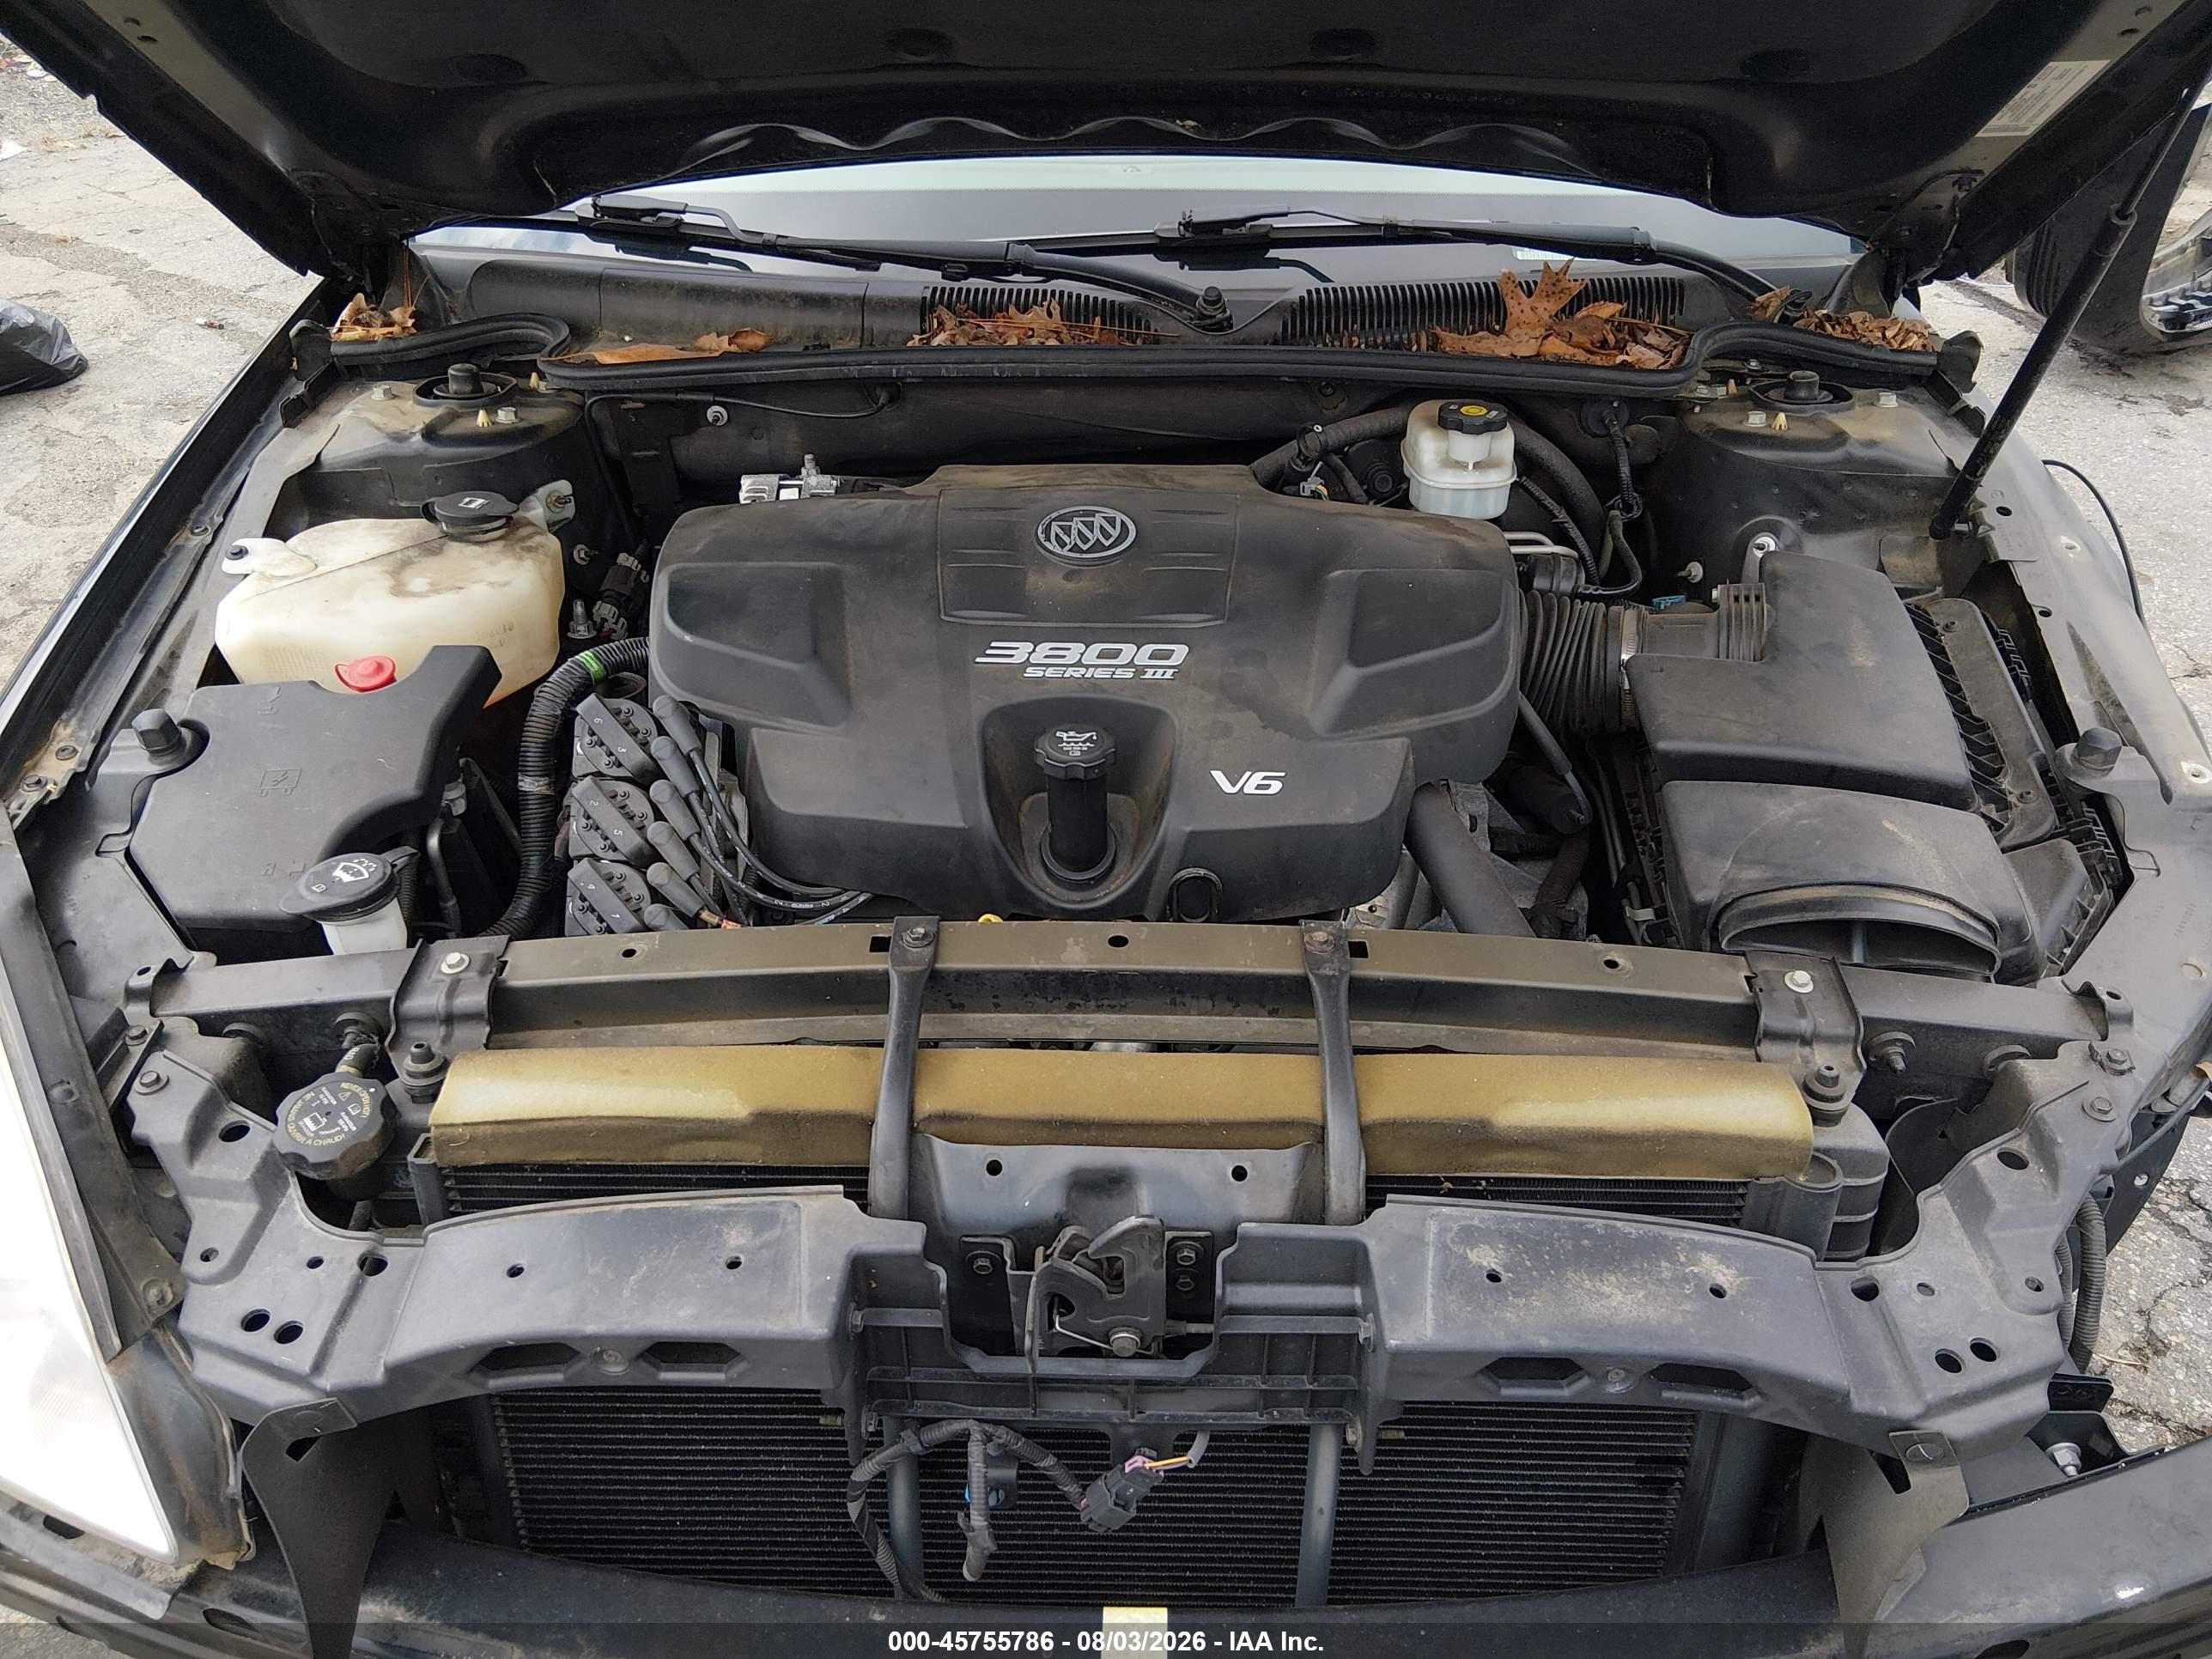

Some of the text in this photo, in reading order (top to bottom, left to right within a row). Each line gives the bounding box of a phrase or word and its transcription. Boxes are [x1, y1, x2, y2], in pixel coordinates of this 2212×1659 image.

[975, 641, 1189, 665] 3800
[1024, 666, 1178, 679] SERIES III
[617, 746, 627, 755] 3
[1210, 770, 1286, 794] V6
